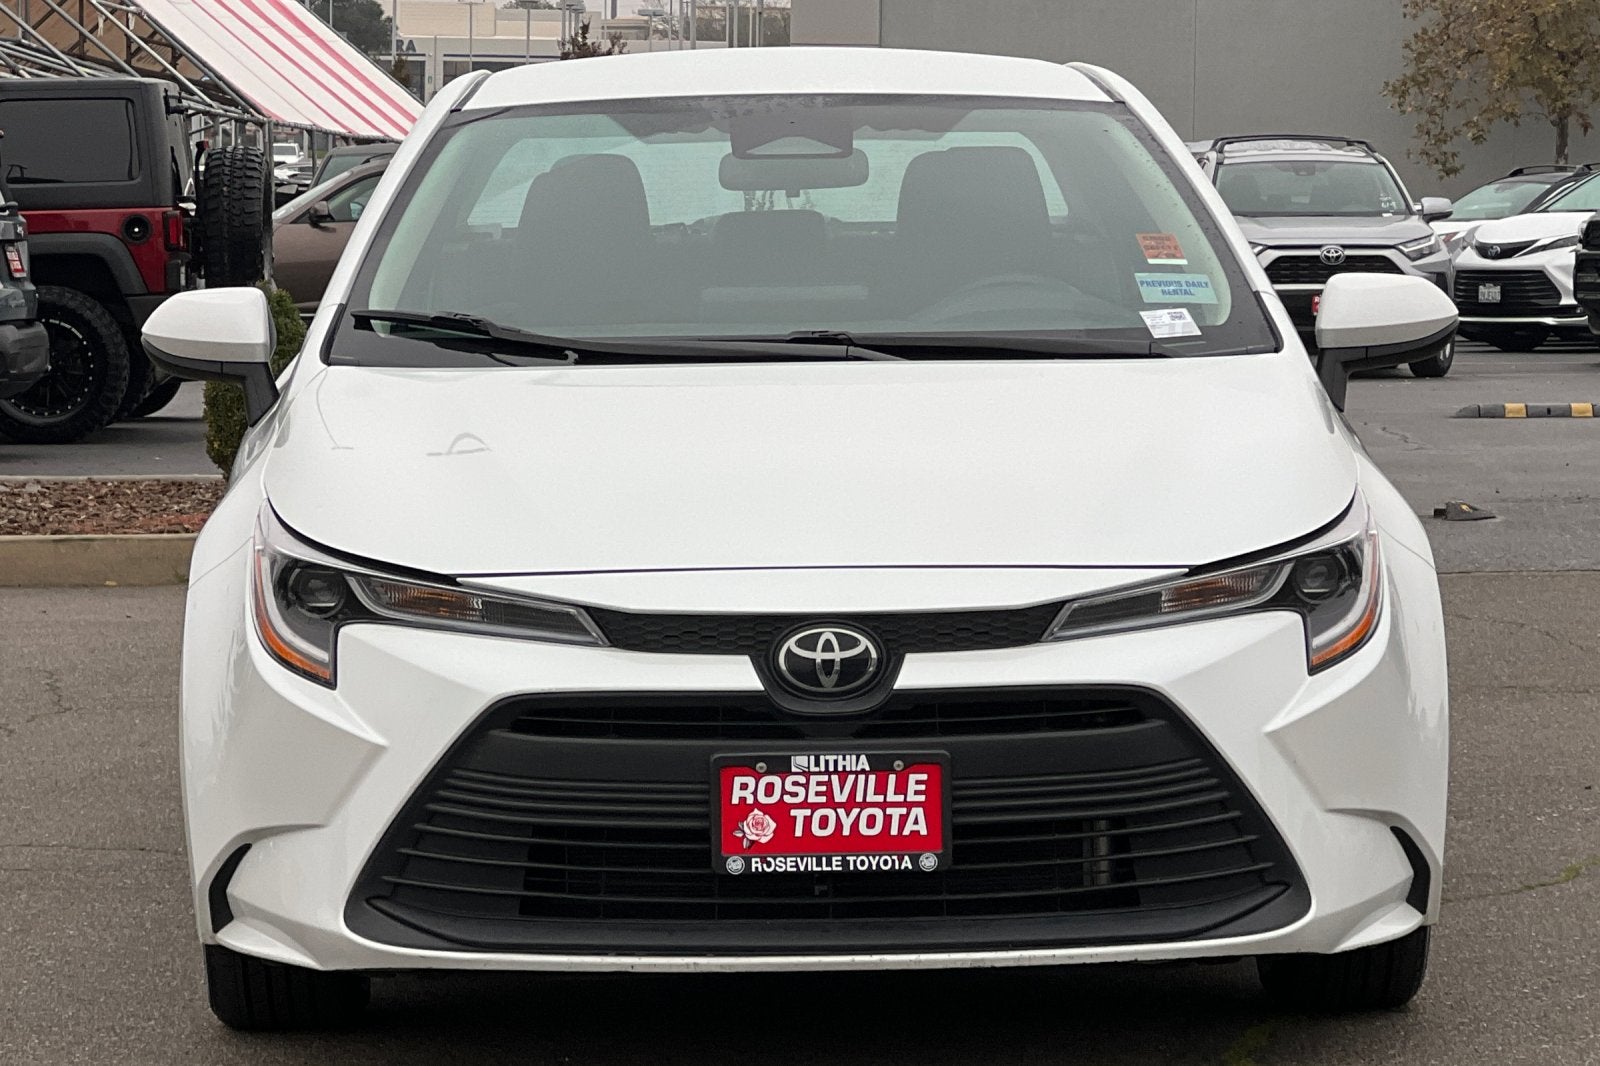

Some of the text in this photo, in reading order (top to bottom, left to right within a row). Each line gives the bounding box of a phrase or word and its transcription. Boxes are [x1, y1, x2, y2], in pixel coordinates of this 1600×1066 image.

[1140, 280, 1183, 288] PREVIOUS
[1162, 288, 1195, 296] RENTAL
[809, 754, 871, 772] LITHIA
[731, 773, 929, 805] ROSEVILLE
[789, 807, 928, 837] TOYOTA
[751, 855, 913, 872] ROSEVILLE TOYOTA
